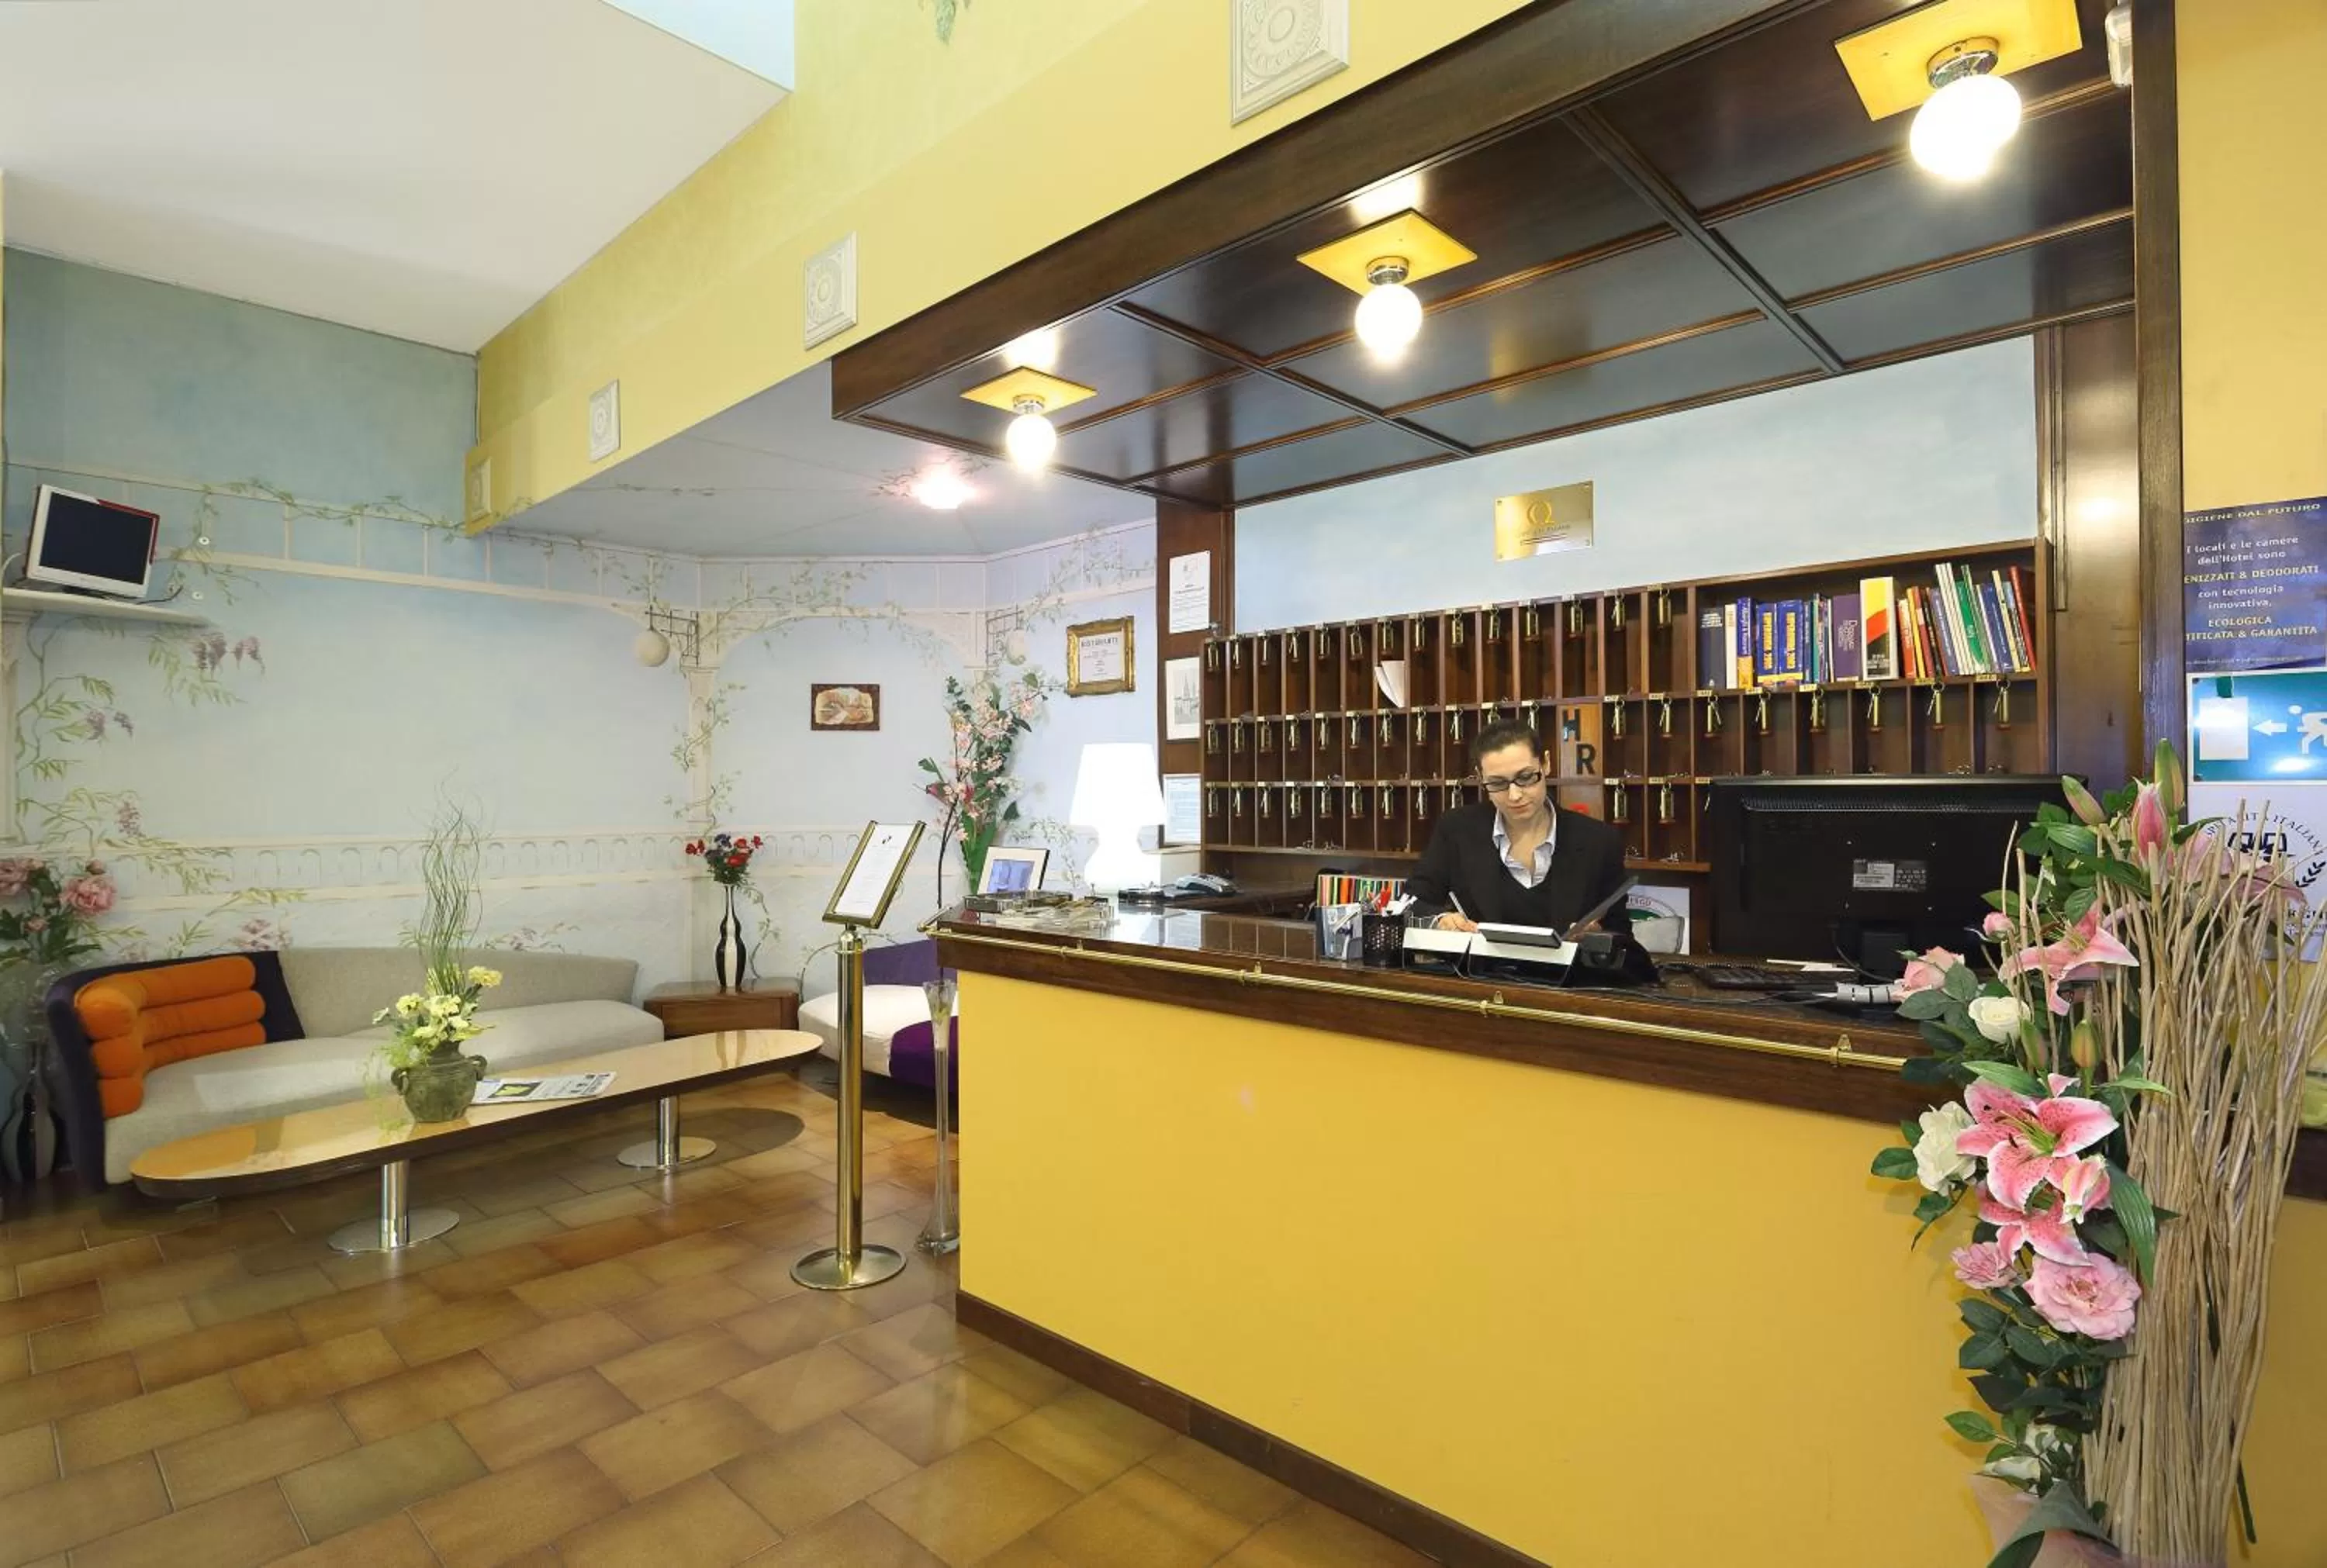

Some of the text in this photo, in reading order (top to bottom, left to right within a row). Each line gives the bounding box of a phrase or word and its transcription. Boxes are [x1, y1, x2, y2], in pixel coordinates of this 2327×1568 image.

[2238, 510, 2264, 519] DAL
[2267, 503, 2320, 516] FUTURO
[2194, 542, 2225, 554] locali
[2241, 540, 2251, 549] le
[2256, 537, 2298, 547] camere
[2197, 551, 2286, 565] dell'Hotel sono
[2239, 571, 2247, 579] &
[2252, 565, 2319, 579] DEODORATI
[2198, 584, 2284, 599] con tecnologia
[2208, 616, 2272, 627] ECOLOGICA
[2238, 630, 2247, 638] &
[2250, 626, 2318, 638] GARANTITA
[1576, 743, 1596, 774] R
